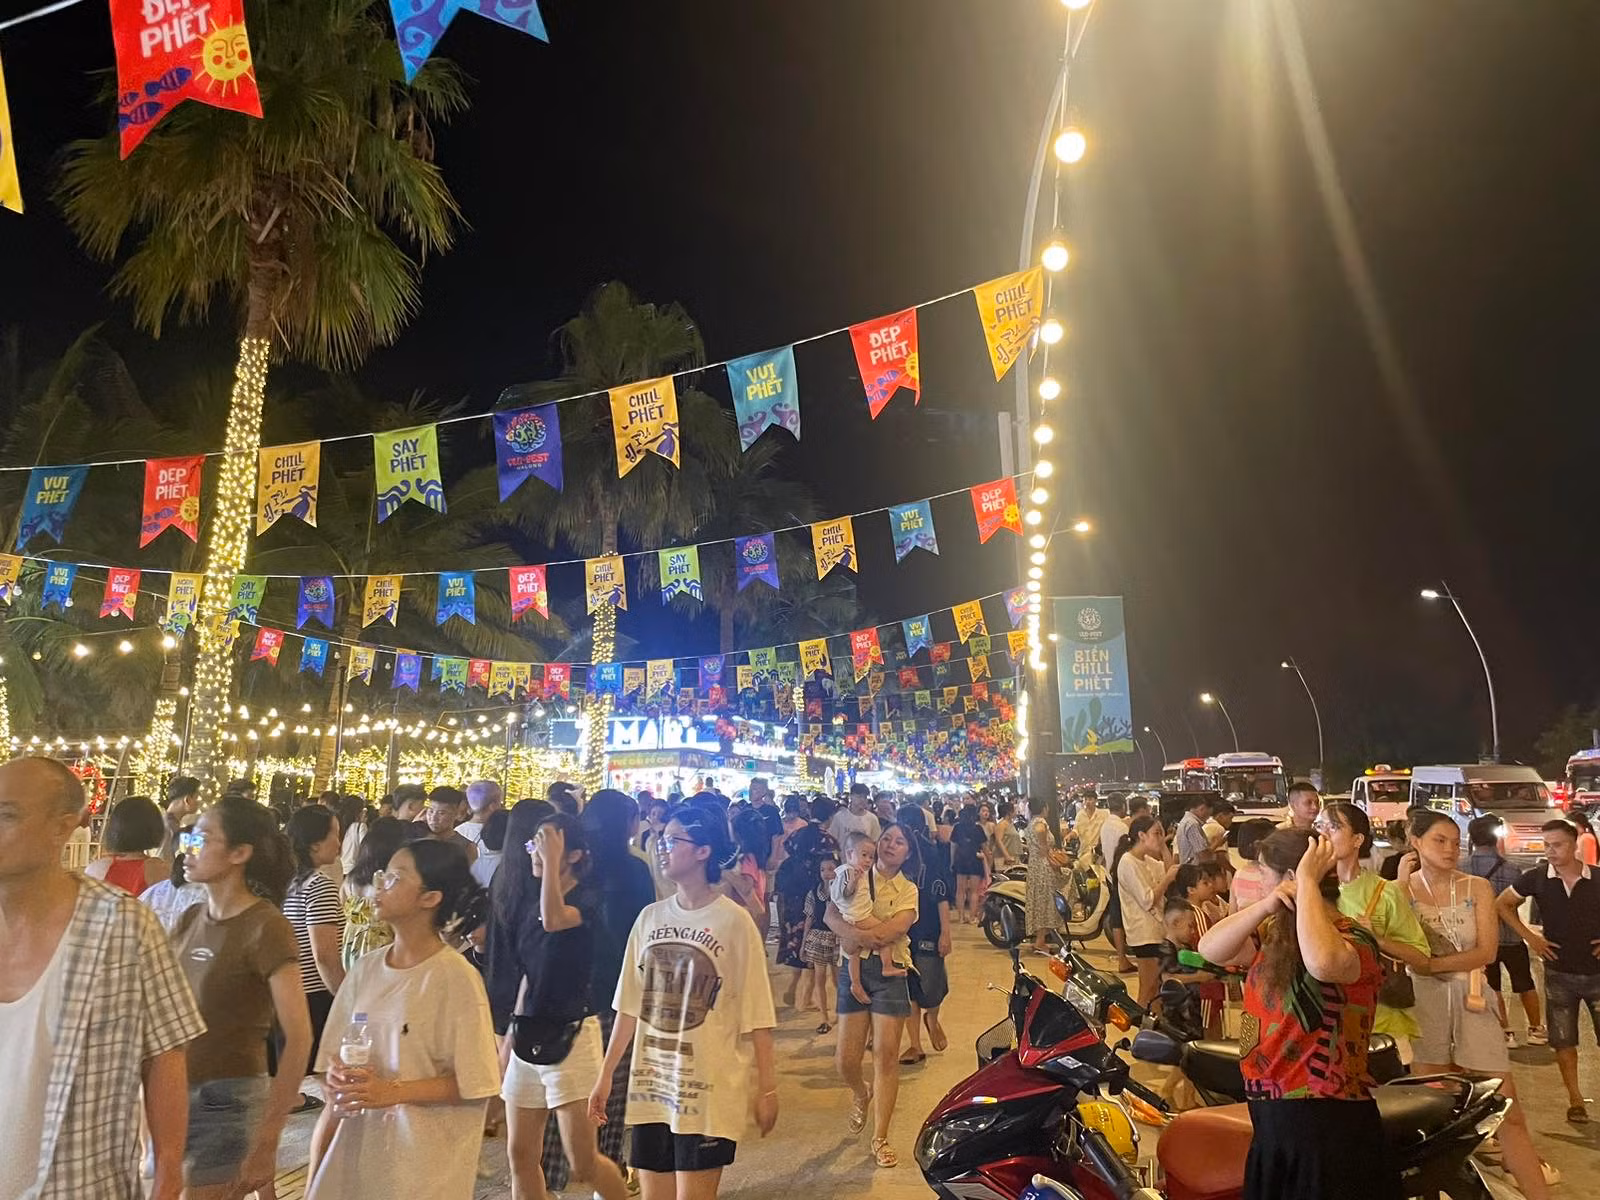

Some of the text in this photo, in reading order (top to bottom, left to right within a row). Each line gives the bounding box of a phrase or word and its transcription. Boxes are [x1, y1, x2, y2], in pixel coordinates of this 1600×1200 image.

[996, 282, 1030, 305] CHILL
[746, 362, 776, 384] VUI
[629, 388, 661, 408] CHILL
[392, 438, 419, 458] SAY
[274, 451, 305, 469] CHILL
[44, 476, 70, 490] VUI
[900, 509, 920, 521] VUI
[822, 524, 843, 536] CHILL
[669, 554, 687, 566] SAY
[240, 581, 256, 591] SAY
[448, 578, 464, 588] VUI
[1072, 662, 1113, 675] CHILL
